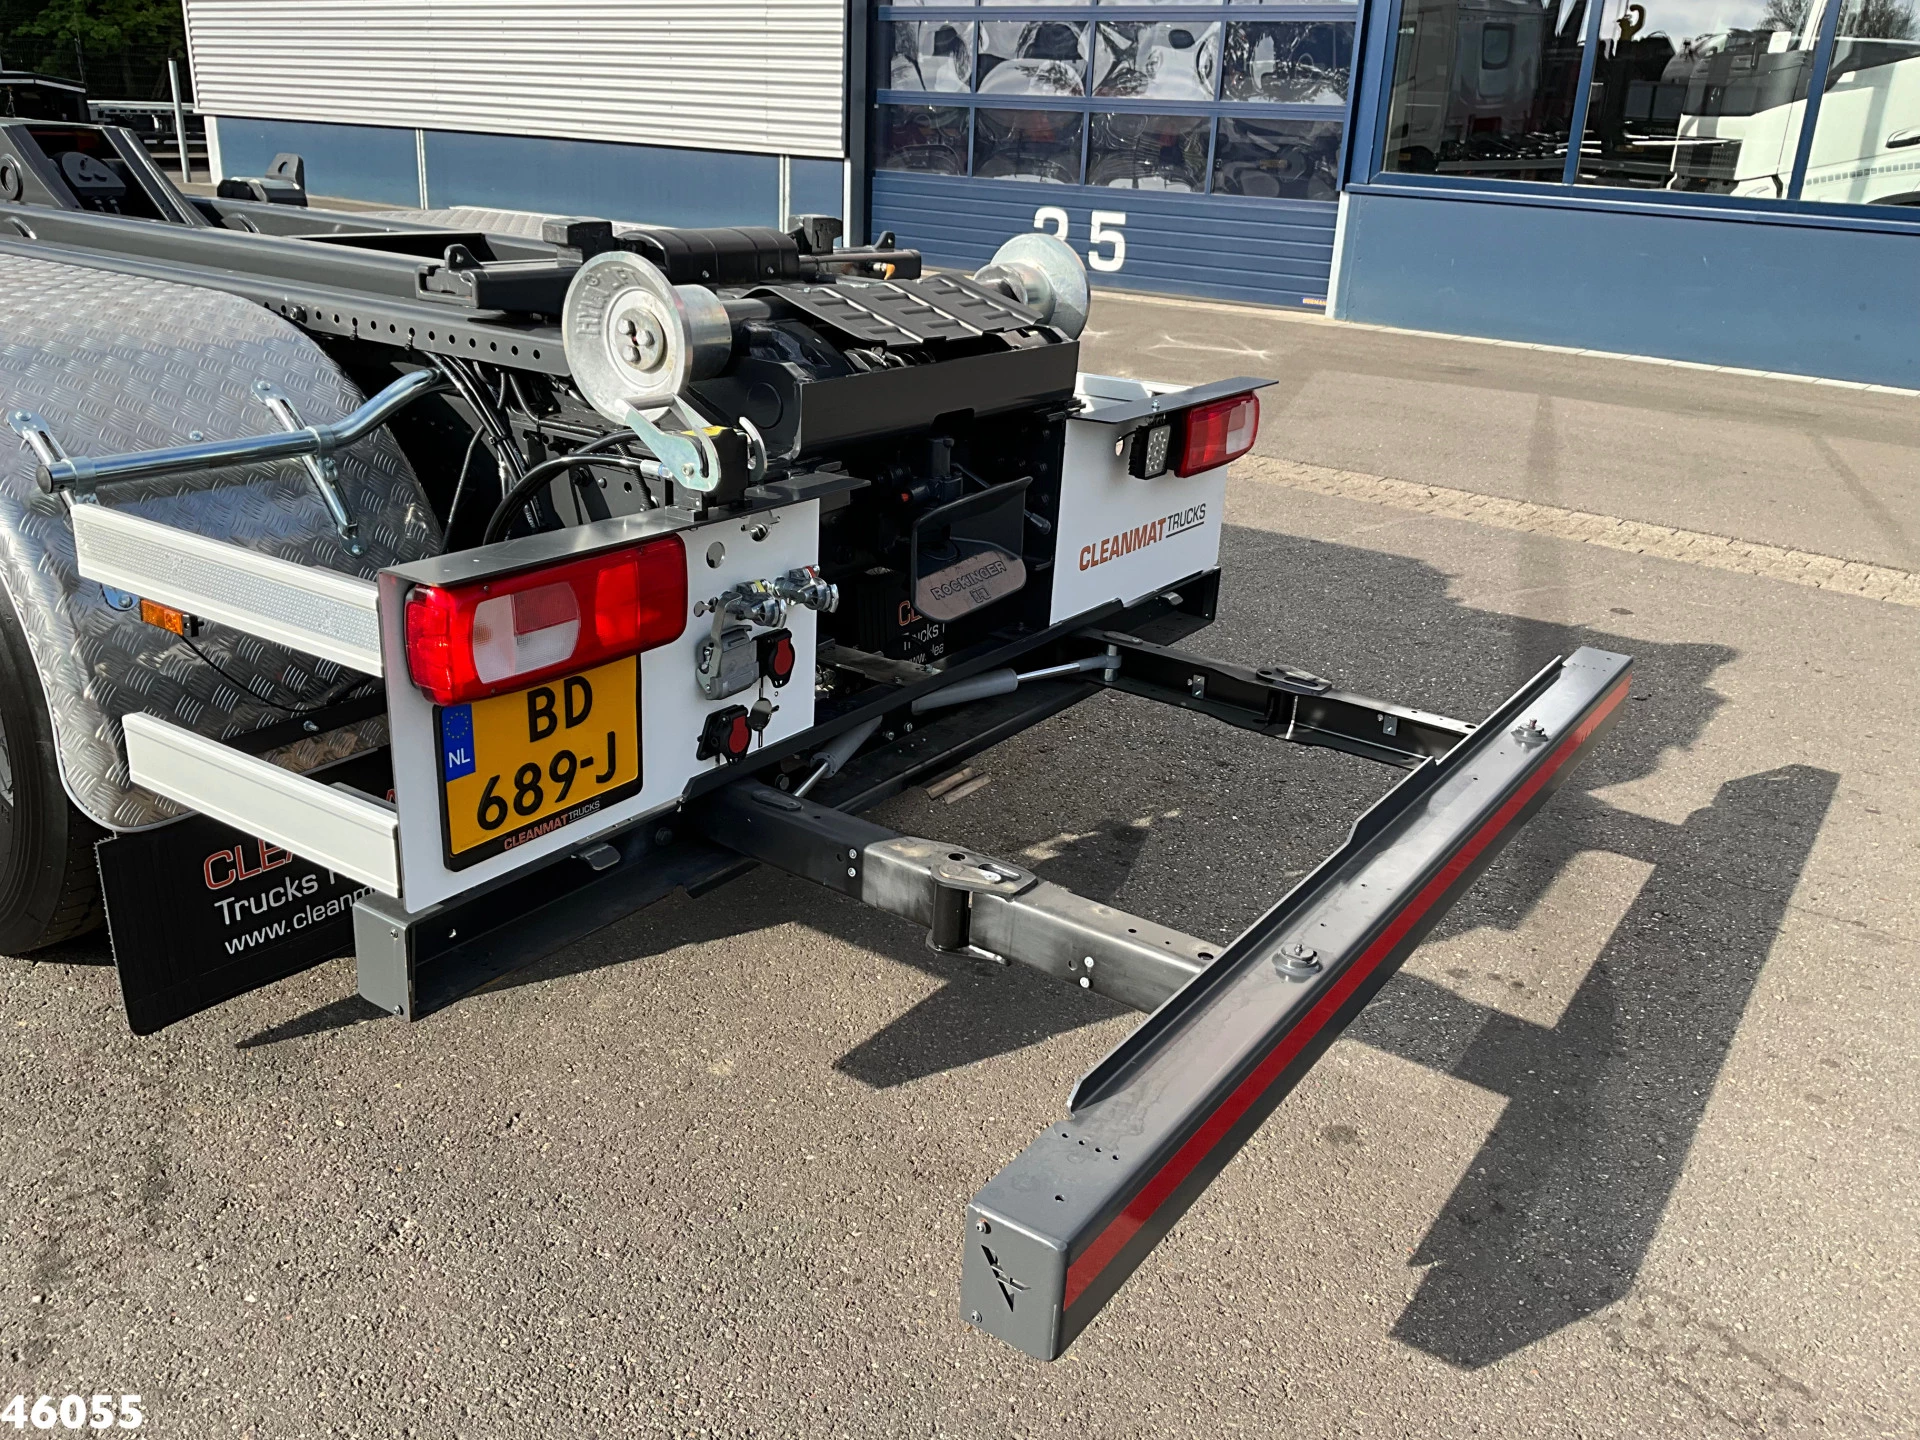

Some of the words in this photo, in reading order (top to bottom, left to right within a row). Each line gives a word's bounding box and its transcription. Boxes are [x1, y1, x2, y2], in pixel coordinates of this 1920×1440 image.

[1079, 517, 1167, 572] CLEANMAT
[1167, 502, 1207, 532] TRUCKS
[930, 560, 1008, 601] ROCKINGER
[527, 675, 593, 743] BD
[448, 748, 471, 768] NL
[477, 730, 617, 831] 689-J
[504, 813, 569, 850] CLEANMAT
[569, 800, 601, 820] TRUCKS
[214, 873, 319, 926] Trucks
